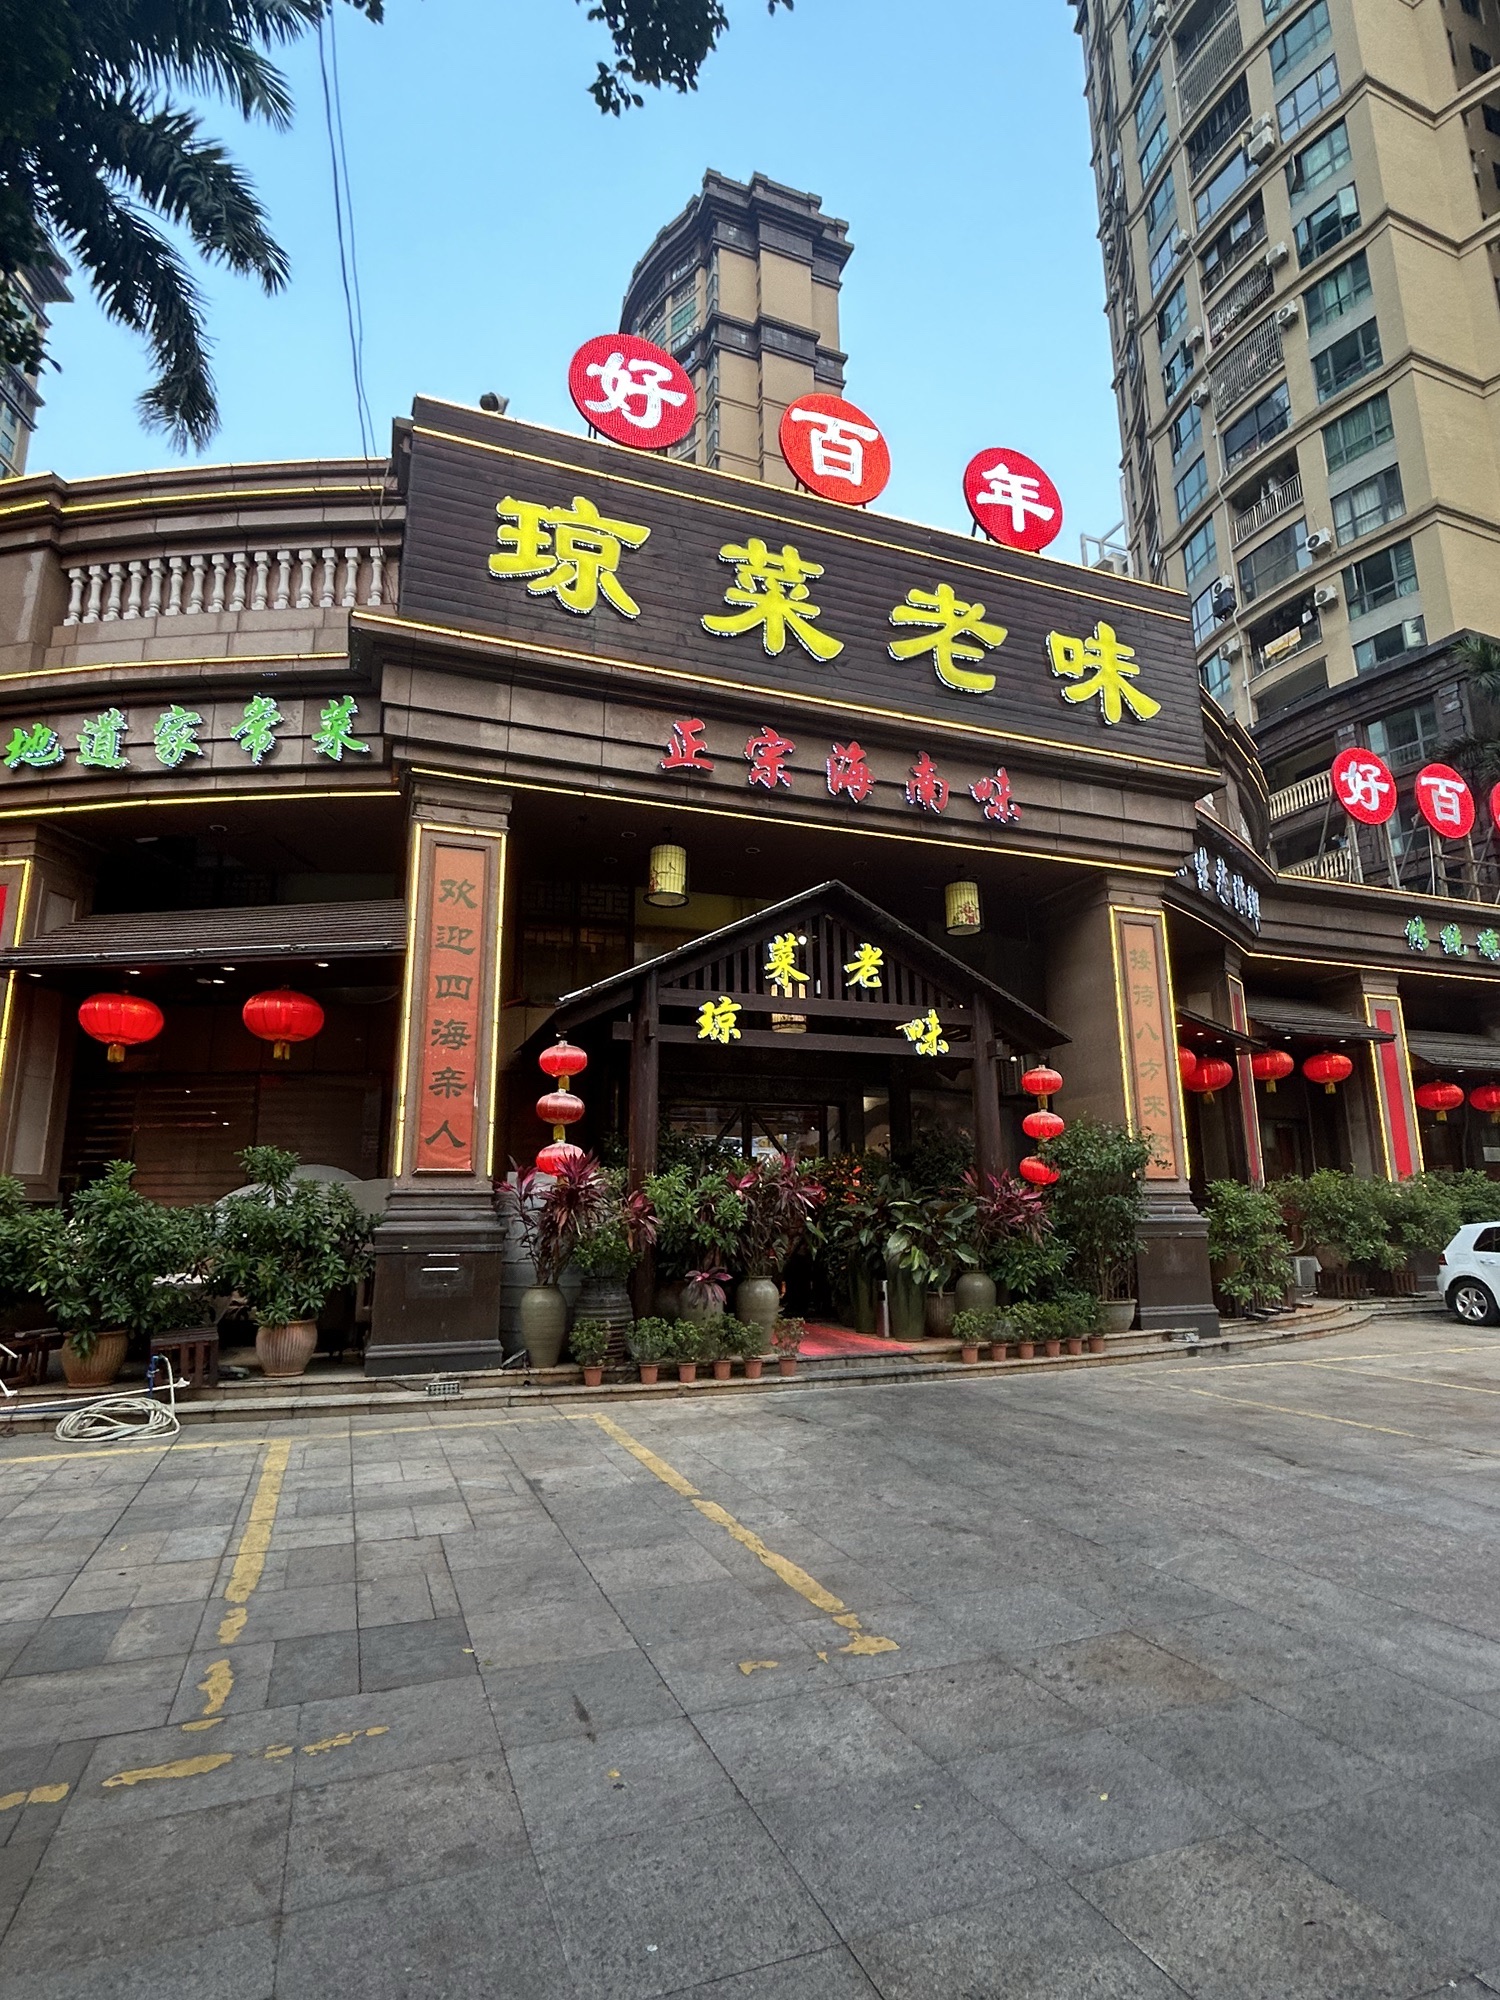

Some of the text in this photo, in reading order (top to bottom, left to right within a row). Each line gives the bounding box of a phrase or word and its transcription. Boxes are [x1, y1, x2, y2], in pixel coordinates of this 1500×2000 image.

[585, 351, 1055, 532] 好百年
[488, 495, 1162, 727] 琼菜老味
[2, 692, 371, 770] 地道家常菜
[659, 717, 1023, 824] 正宗海南味
[424, 877, 478, 1148] 欢迎四海亲人
[695, 931, 950, 1057] 琼菜老味
